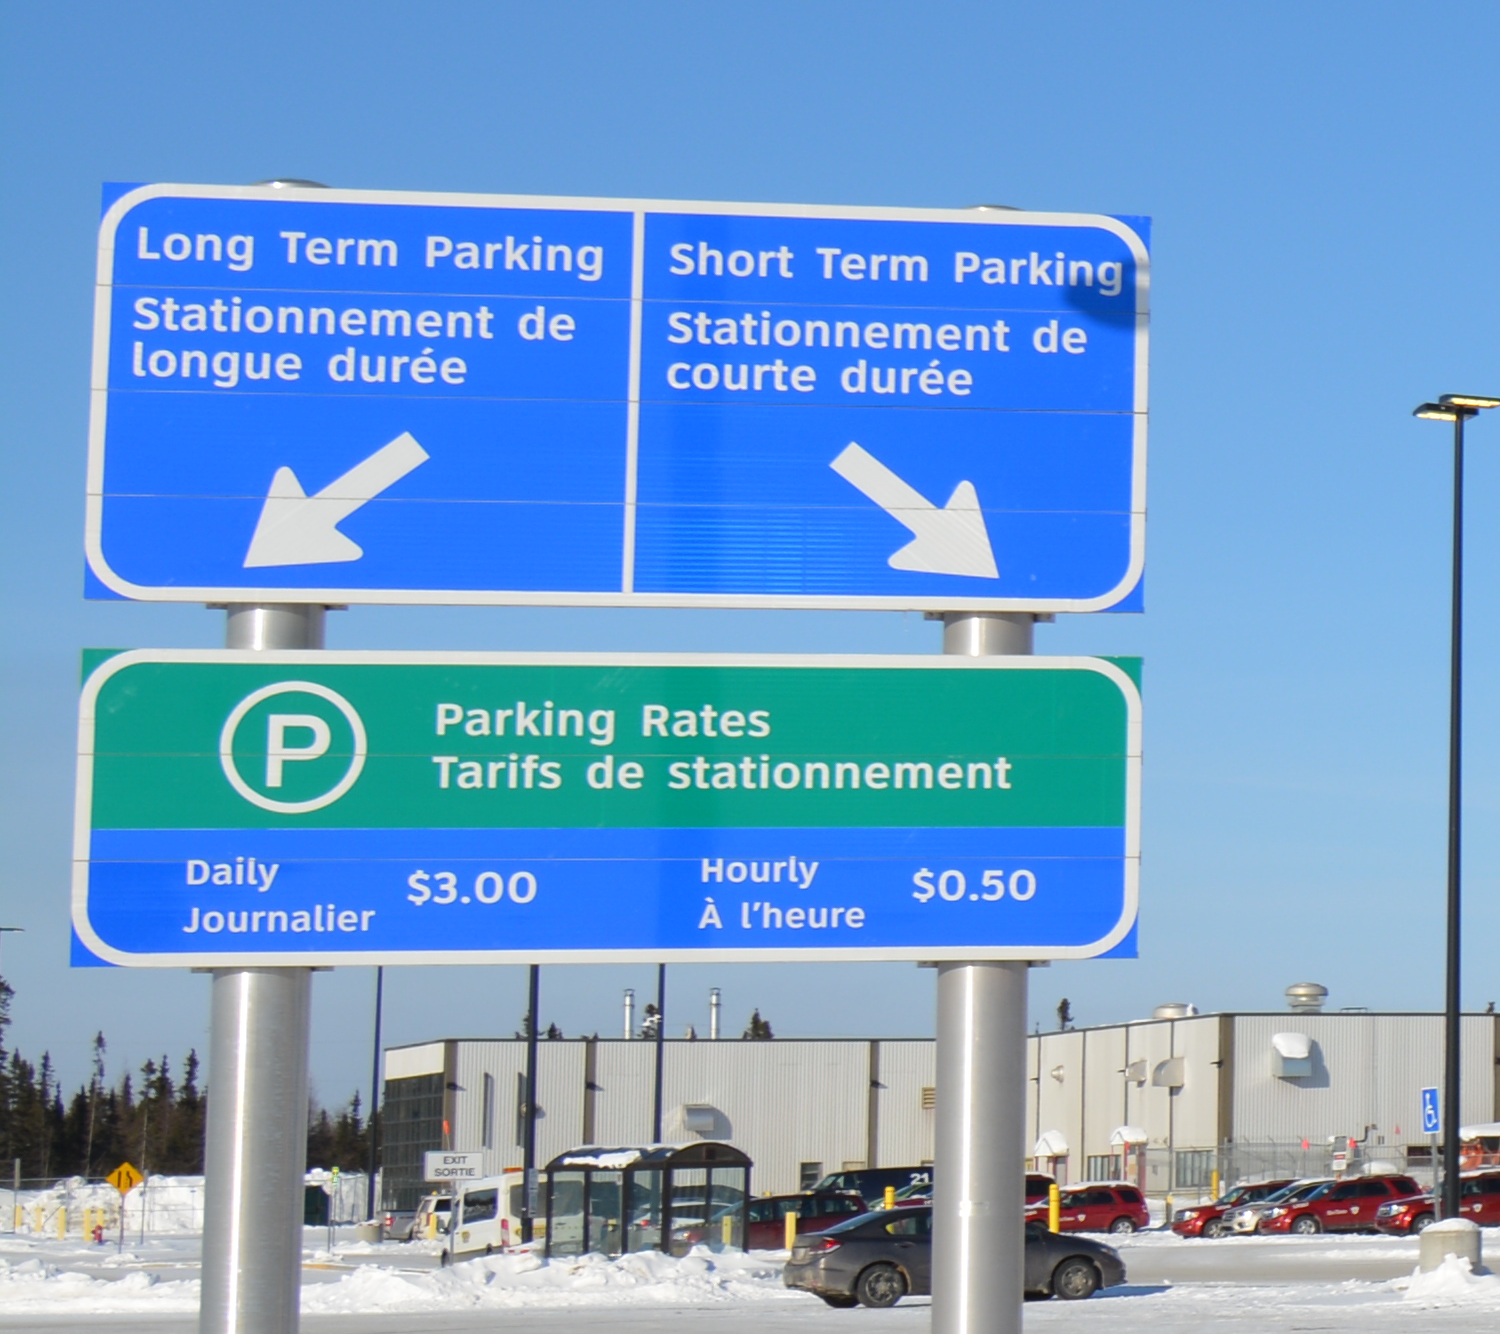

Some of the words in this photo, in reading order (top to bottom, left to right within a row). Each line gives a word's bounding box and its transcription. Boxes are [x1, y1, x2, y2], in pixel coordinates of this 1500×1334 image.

[137, 226, 254, 272] Long
[279, 231, 398, 267] Term
[425, 235, 603, 282] Parking
[669, 241, 794, 279] Short
[815, 247, 929, 282] Term
[954, 251, 1122, 296] Parking
[132, 296, 494, 340] Stationnement
[517, 305, 576, 342] de
[667, 310, 1010, 353] Stationnement
[1032, 319, 1088, 355] de
[132, 341, 302, 388] longue
[327, 346, 467, 385] durée
[666, 358, 817, 393] courte
[840, 359, 973, 396] durée
[436, 700, 616, 747] Parking
[642, 704, 771, 738] Rates
[265, 713, 331, 788] P
[431, 752, 562, 790] Tarifs
[586, 754, 644, 790] de
[668, 754, 1012, 790] stationnement
[186, 856, 279, 893] Daily
[407, 869, 537, 906] $3.00
[701, 855, 819, 890] Hourly
[912, 867, 1037, 903] $0.50
[182, 903, 376, 933] Journalier
[698, 896, 723, 929] À
[741, 901, 865, 929] l'heure
[434, 1167, 476, 1177] SORTIE
[443, 1155, 468, 1165] EXIT
[909, 1172, 930, 1185] 21
